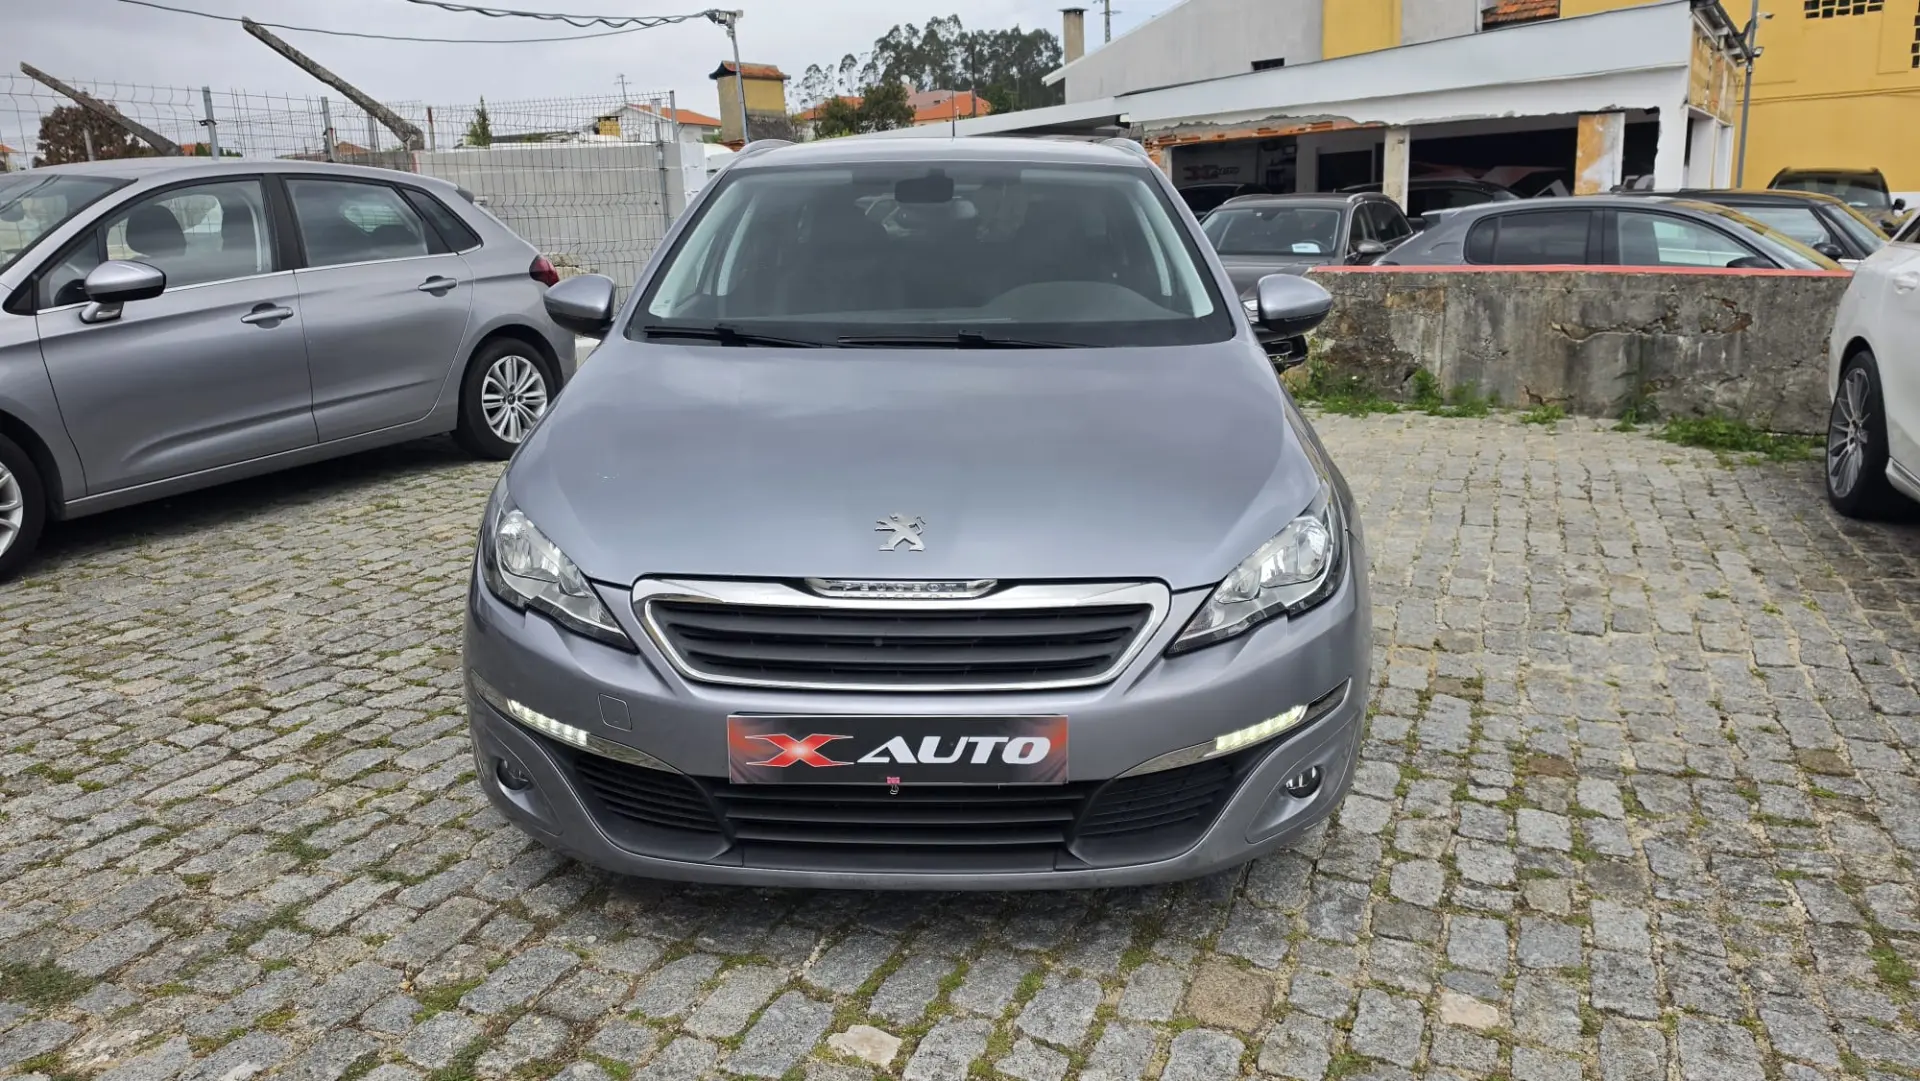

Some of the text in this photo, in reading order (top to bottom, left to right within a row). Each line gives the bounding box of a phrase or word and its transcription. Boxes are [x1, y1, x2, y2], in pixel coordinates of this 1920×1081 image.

[843, 582, 957, 592] PEUGEOT
[745, 733, 1051, 768] X AUTO
